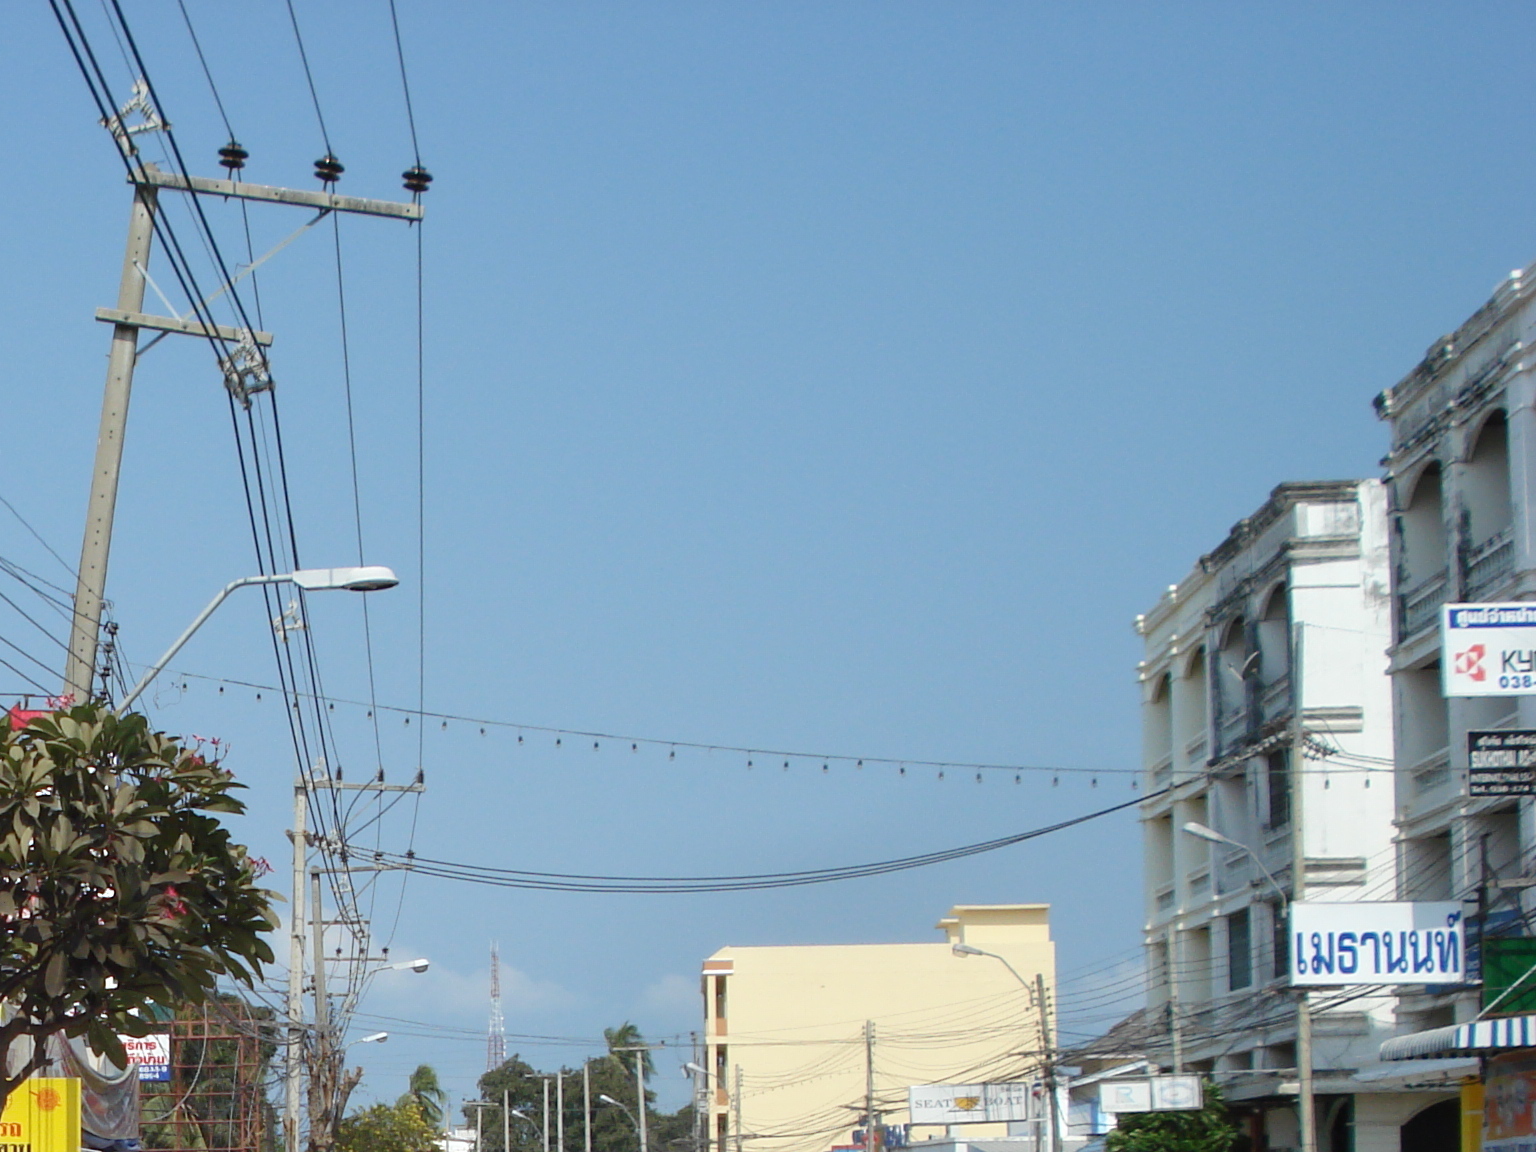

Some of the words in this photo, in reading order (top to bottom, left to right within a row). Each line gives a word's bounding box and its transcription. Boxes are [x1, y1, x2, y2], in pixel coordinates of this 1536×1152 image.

[1502, 650, 1536, 673] KY
[1296, 910, 1462, 975] เมธานนท์
[914, 1099, 952, 1109] SEAT
